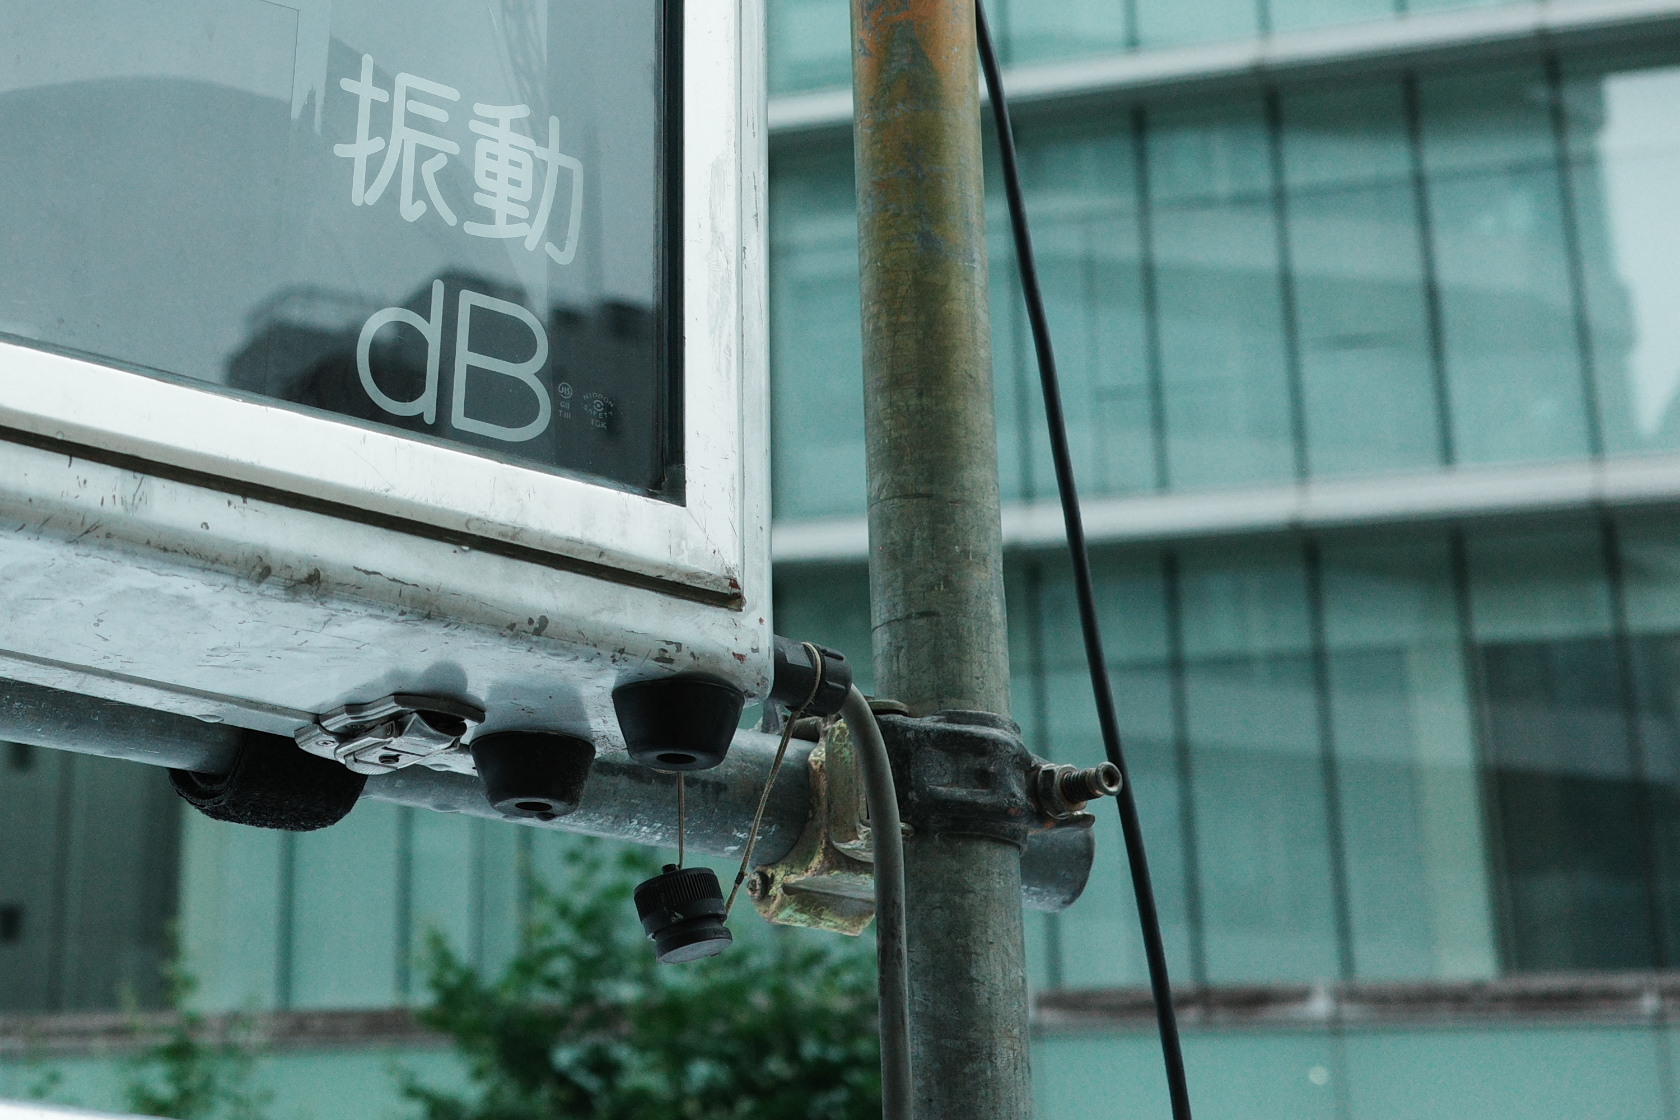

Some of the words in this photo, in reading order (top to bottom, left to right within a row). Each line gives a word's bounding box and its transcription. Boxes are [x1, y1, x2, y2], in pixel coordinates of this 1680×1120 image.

[333, 53, 584, 266] 振動
[356, 278, 552, 442] dB
[583, 392, 614, 407] NIPPON
[583, 404, 613, 418] SAFETY
